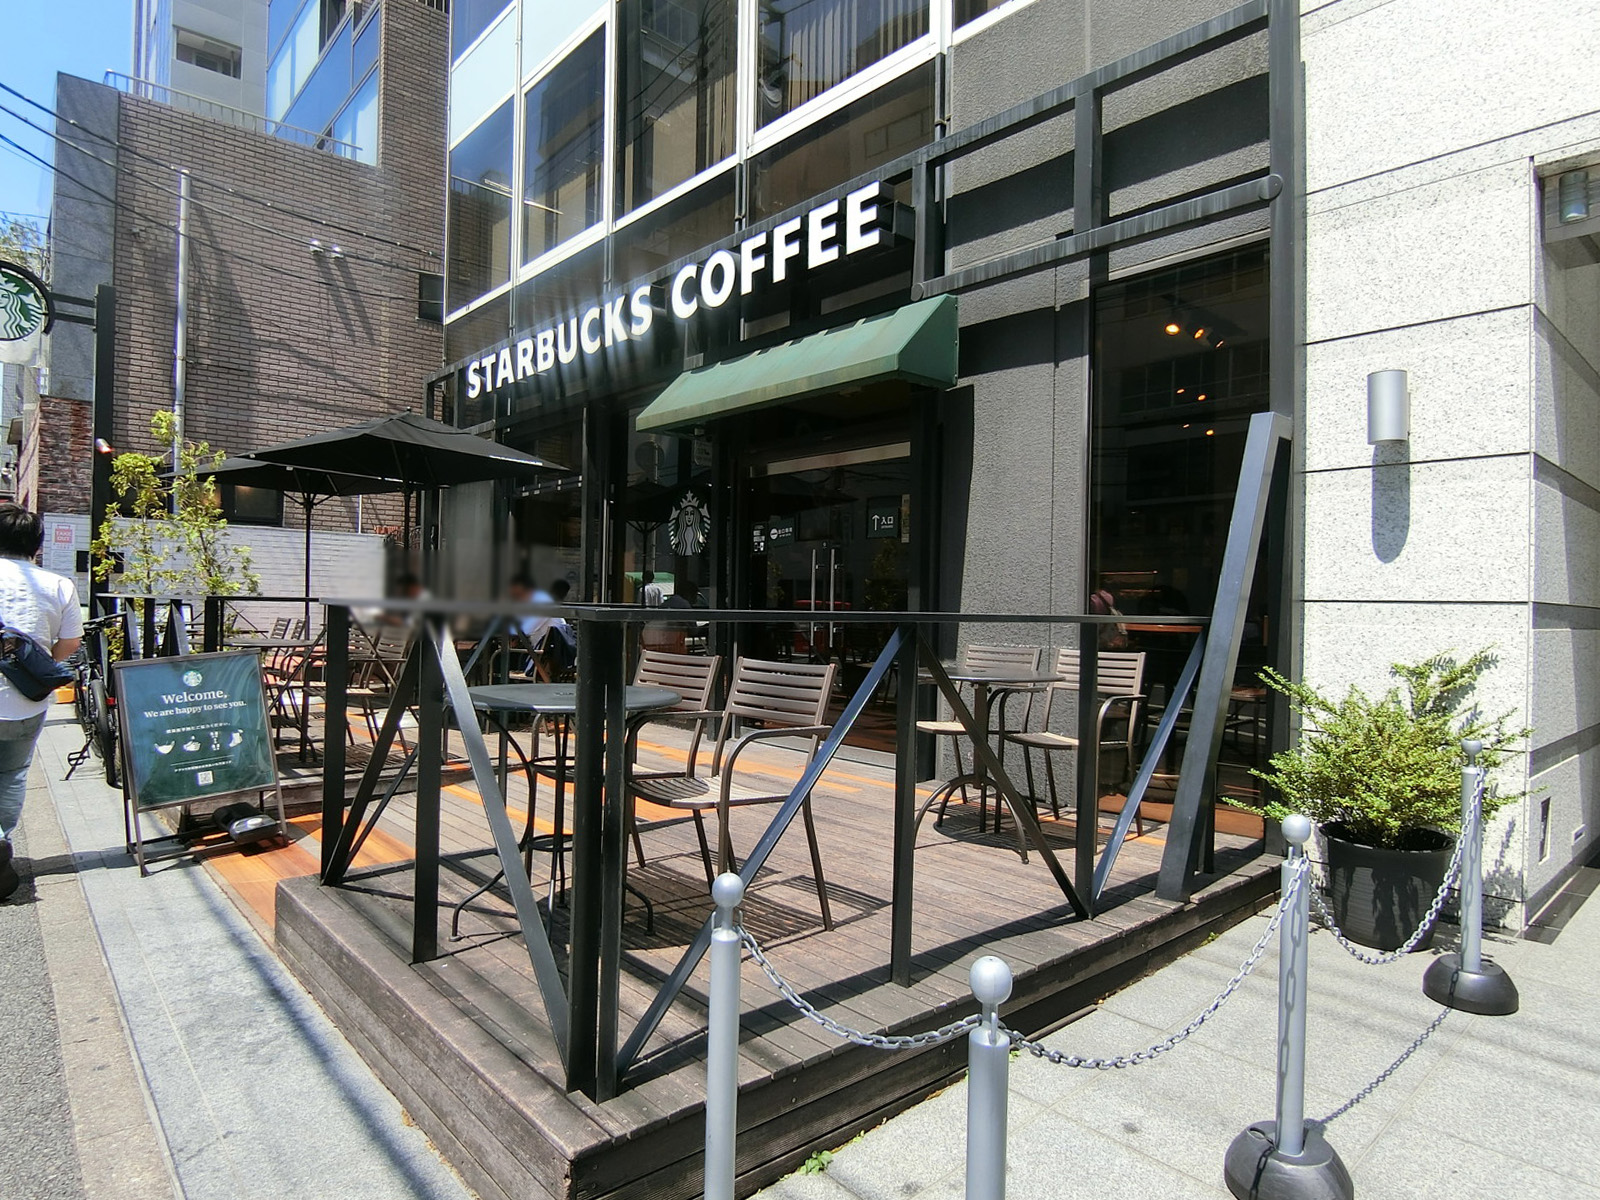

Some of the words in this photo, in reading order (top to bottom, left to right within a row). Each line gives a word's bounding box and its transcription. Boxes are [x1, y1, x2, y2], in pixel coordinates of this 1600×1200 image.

[467, 285, 653, 399] STARBUCKS
[671, 180, 880, 319] COFFEE
[880, 516, 894, 525] 入口
[162, 689, 228, 704] Welcome,
[144, 710, 158, 718] We
[159, 708, 175, 716] are
[175, 705, 203, 715] happy
[228, 700, 247, 709] you.
